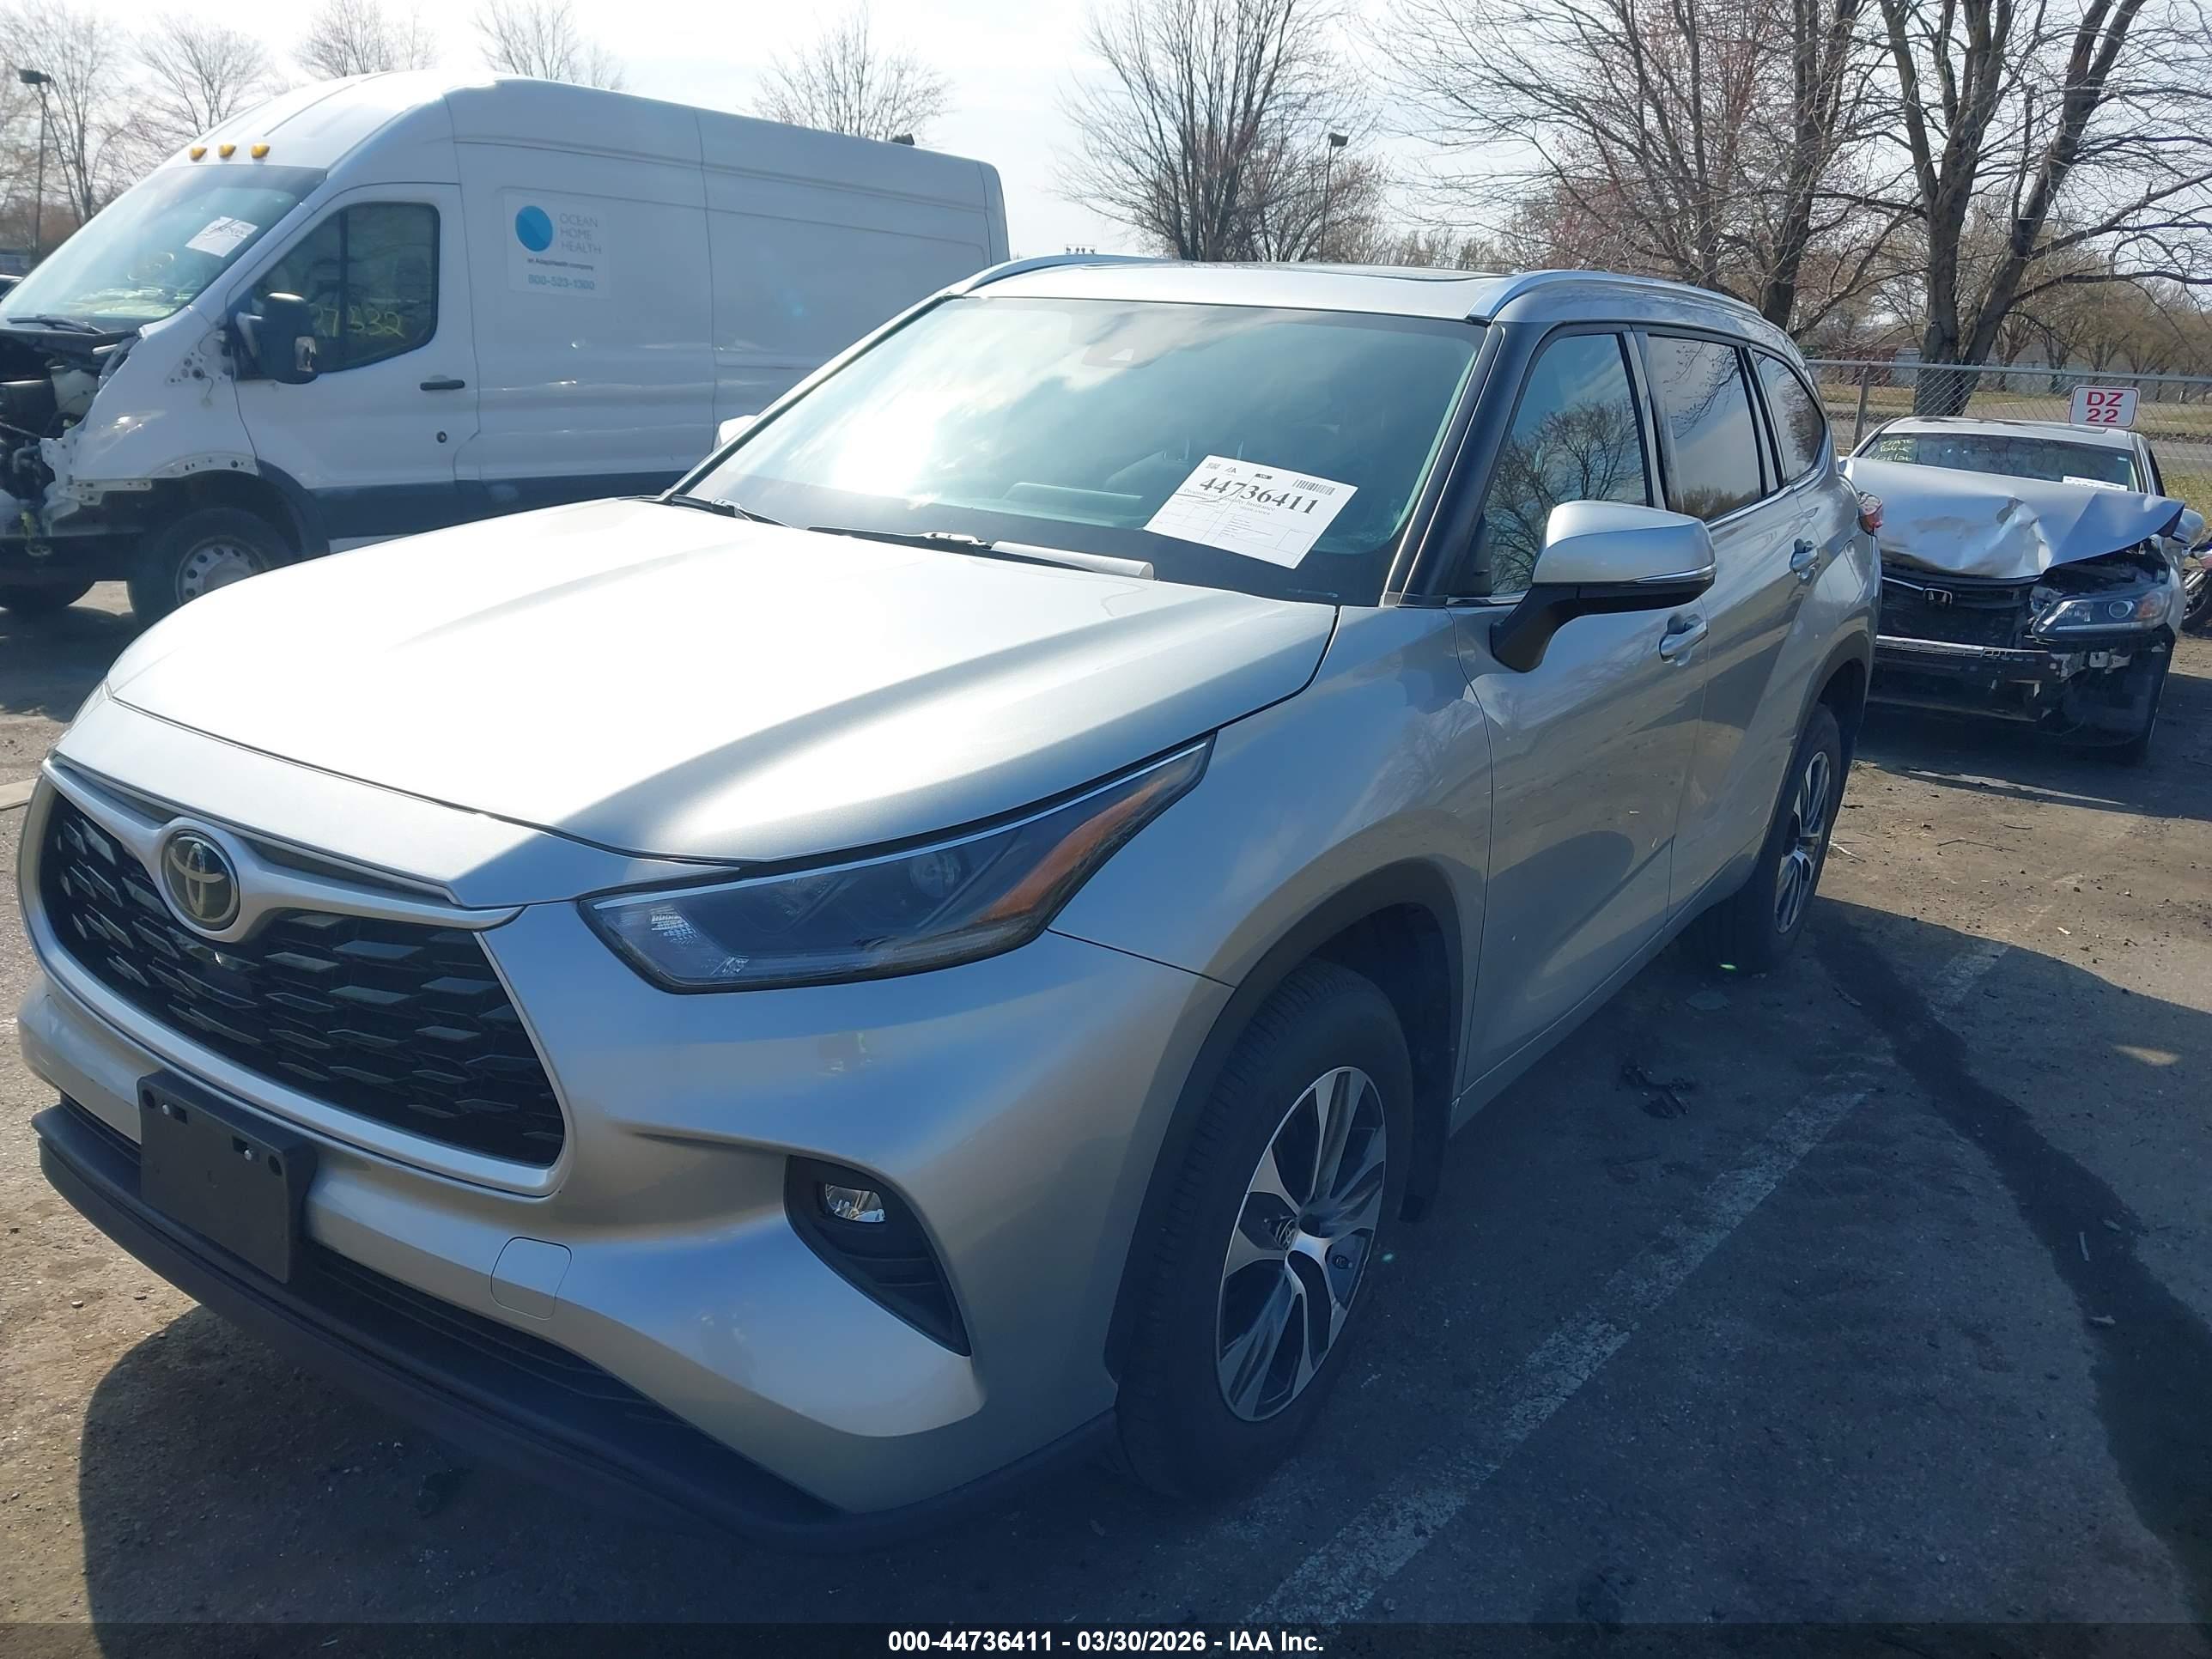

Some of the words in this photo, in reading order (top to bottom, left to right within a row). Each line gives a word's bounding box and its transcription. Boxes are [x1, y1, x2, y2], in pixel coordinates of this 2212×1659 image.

[559, 213, 599, 228] OCEAN
[560, 227, 592, 240] HOME
[561, 240, 602, 255] HEALTH
[2086, 391, 2124, 407] DZ
[2085, 408, 2118, 422] 22
[1200, 477, 1320, 515] 44736411
